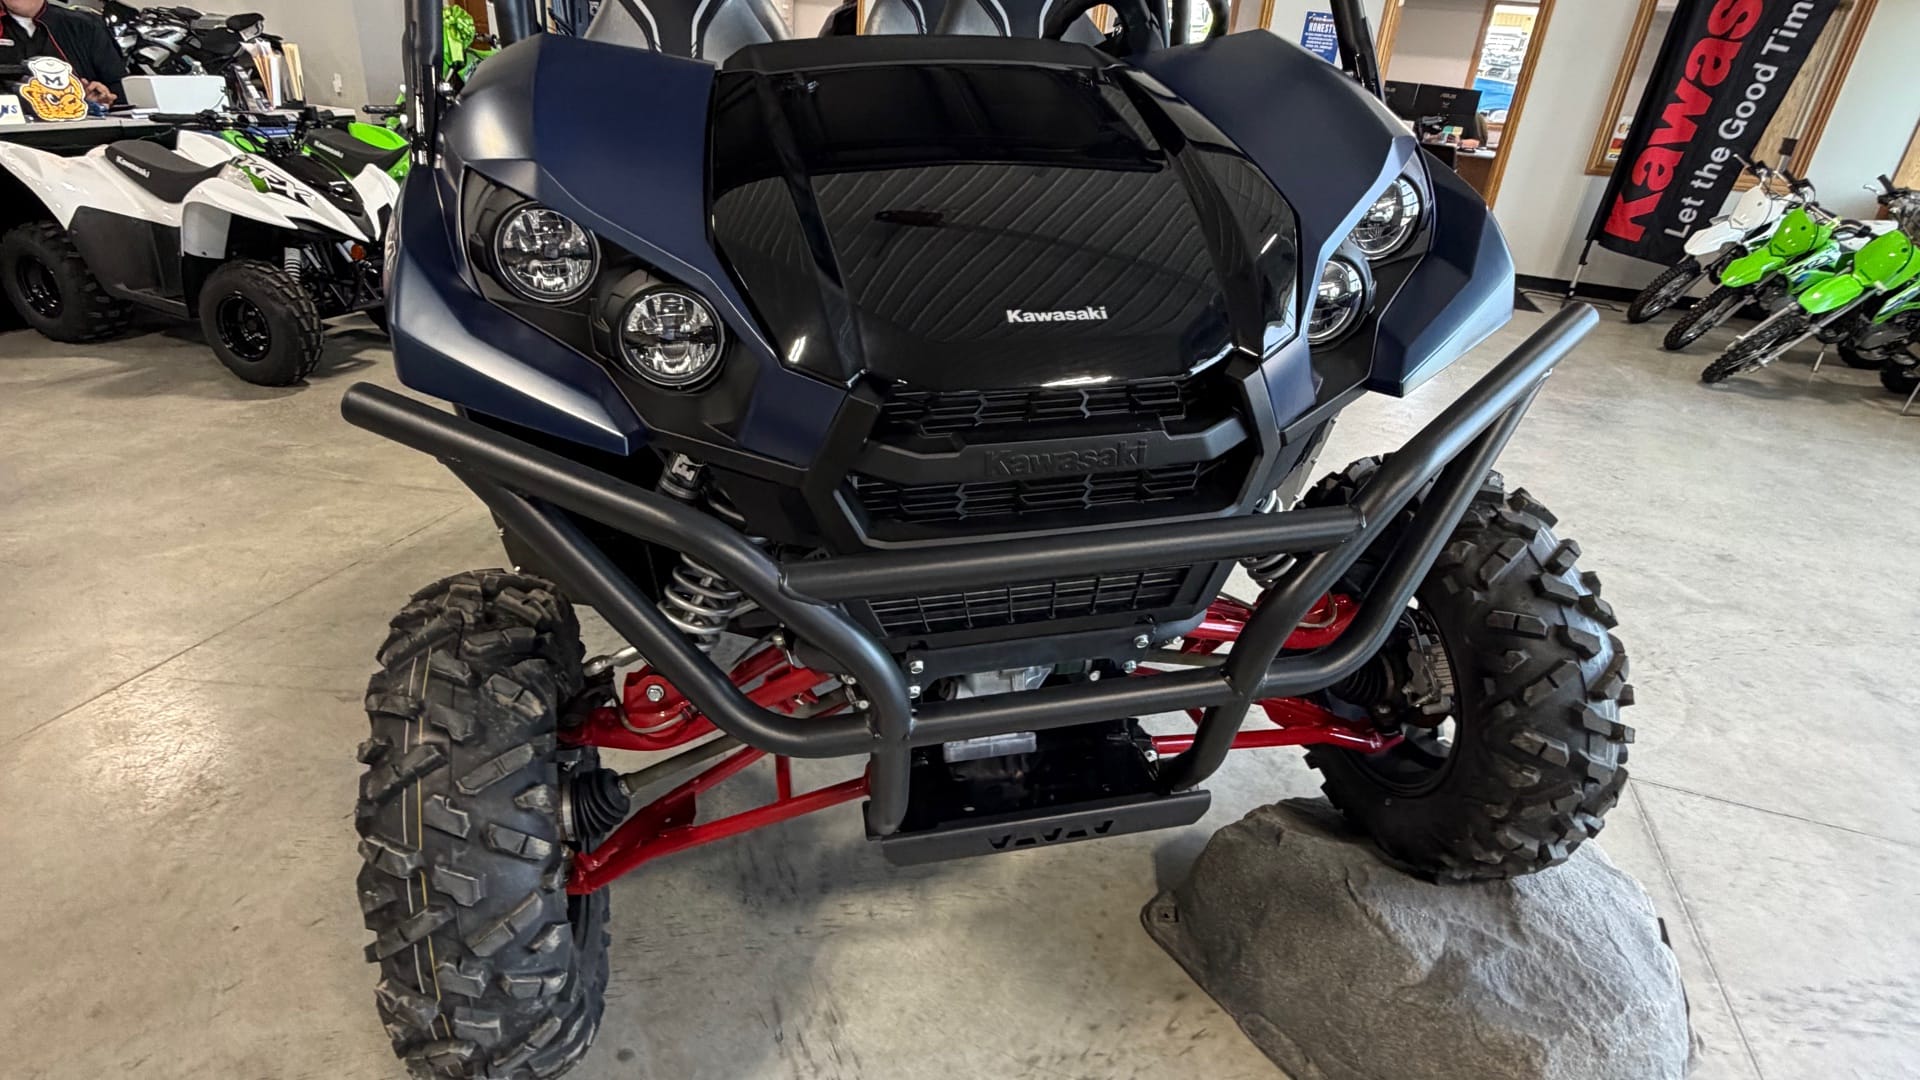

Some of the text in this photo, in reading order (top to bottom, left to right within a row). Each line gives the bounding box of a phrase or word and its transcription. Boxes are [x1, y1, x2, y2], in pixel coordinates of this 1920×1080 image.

[42, 75, 63, 86] M
[1604, 0, 1763, 242] Kawas
[1664, 0, 1815, 239] Let the Good Tim
[1006, 305, 1108, 323] Kawasaki
[984, 439, 1148, 476] Kawasaki
